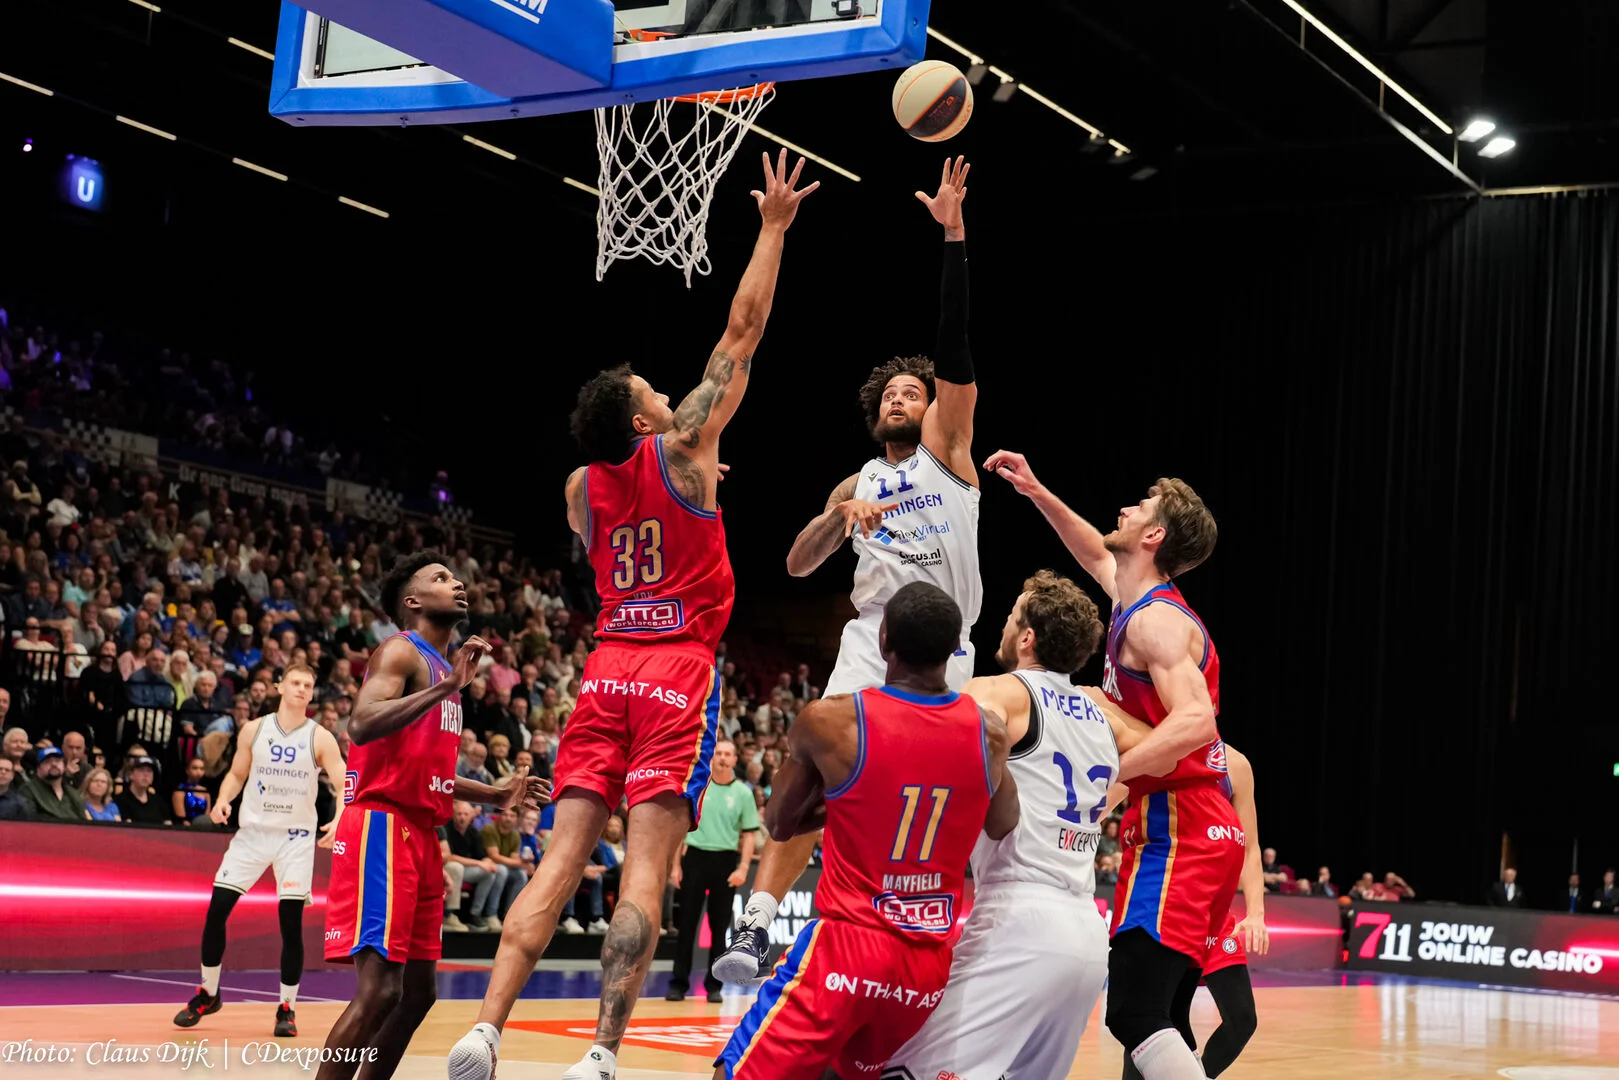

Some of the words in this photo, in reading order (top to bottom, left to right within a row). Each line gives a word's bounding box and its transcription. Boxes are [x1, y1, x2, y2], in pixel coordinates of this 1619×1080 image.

[77, 176, 95, 202] U
[877, 470, 914, 500] 11
[611, 517, 664, 592] 33
[649, 686, 688, 709] ASS
[270, 745, 297, 764] 99
[1052, 751, 1113, 824] 12
[889, 784, 953, 863] 11
[1207, 825, 1232, 841] ON
[883, 873, 942, 893] MAYFIELD
[1418, 921, 1495, 946] JOUW
[1418, 940, 1505, 967] ONLINE
[1509, 948, 1604, 975] CASINO
[825, 971, 859, 995] ON
[862, 979, 919, 1007] THAT
